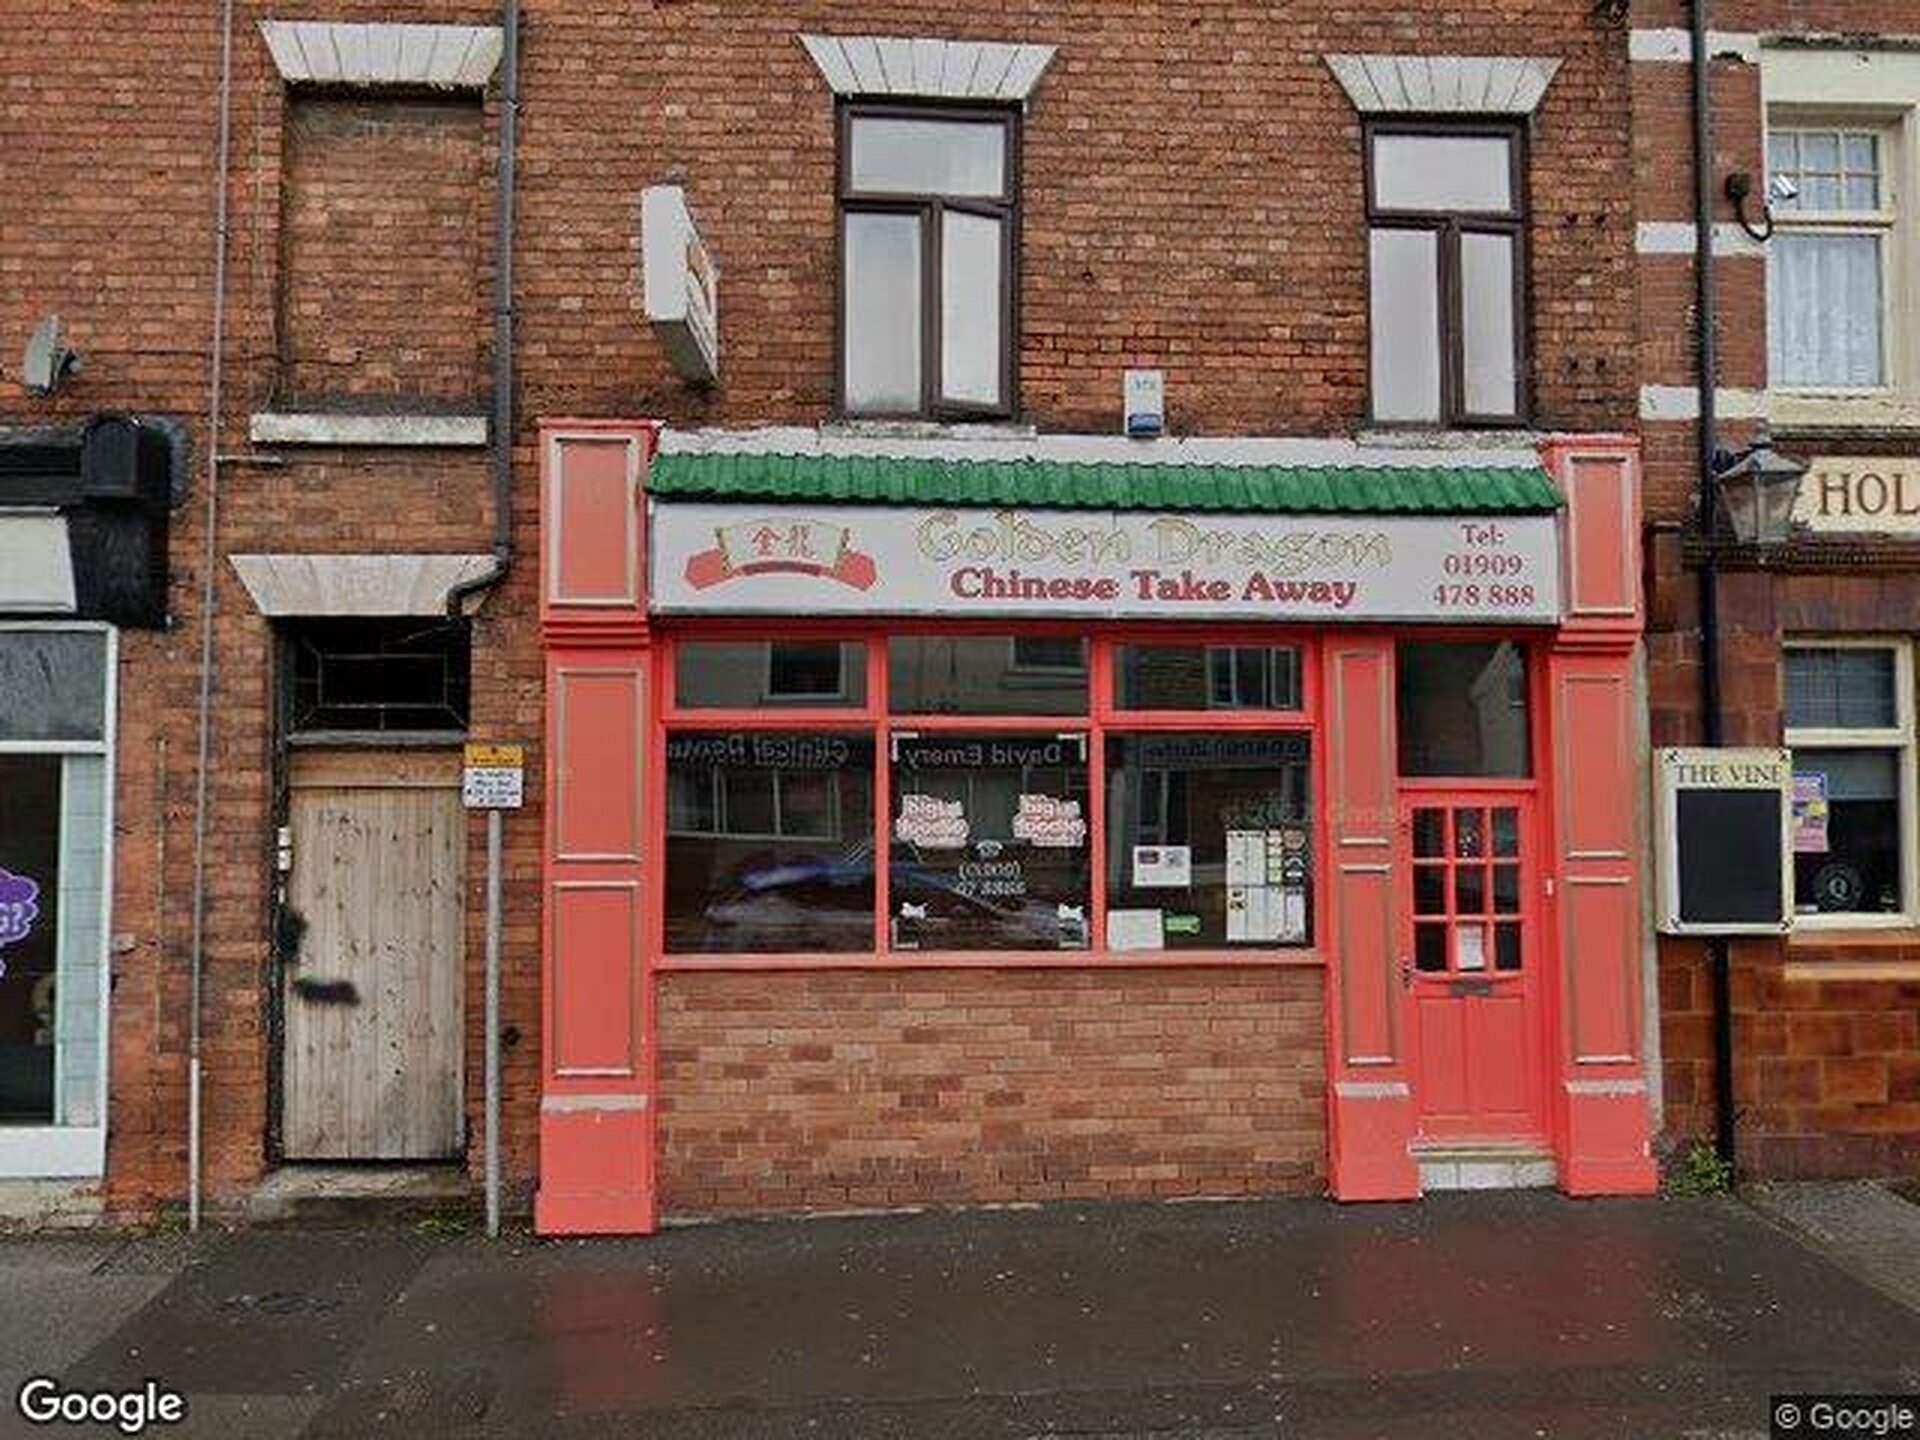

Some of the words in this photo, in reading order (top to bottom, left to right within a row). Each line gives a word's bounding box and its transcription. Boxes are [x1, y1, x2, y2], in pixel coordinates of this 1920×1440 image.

[1818, 472, 1920, 516] HOL
[916, 508, 1132, 564] Golden
[1147, 515, 1393, 576] Dragon
[1461, 523, 1504, 545] Tel:
[1444, 553, 1523, 576] 01909
[950, 566, 1120, 600] Chinese
[1130, 569, 1232, 601] Take
[1242, 570, 1357, 608] Away
[1433, 584, 1480, 606] 478
[1488, 584, 1534, 606] 888
[1676, 764, 1720, 783] THE
[1727, 764, 1782, 783] VINE
